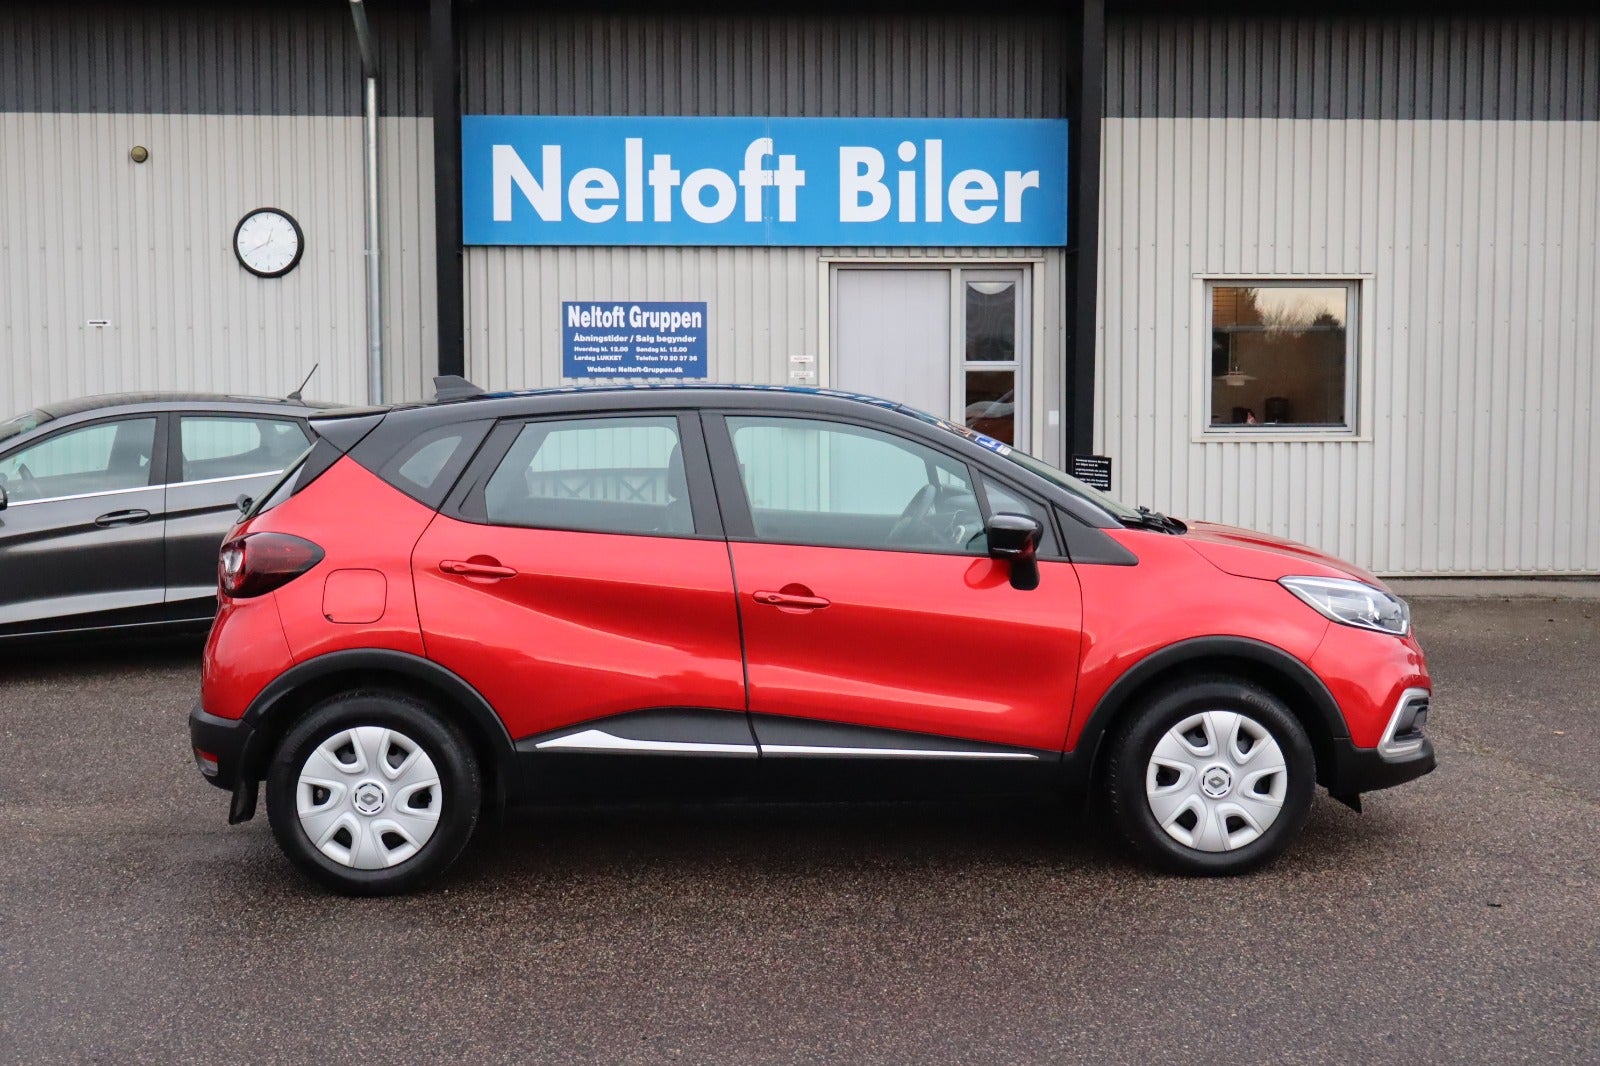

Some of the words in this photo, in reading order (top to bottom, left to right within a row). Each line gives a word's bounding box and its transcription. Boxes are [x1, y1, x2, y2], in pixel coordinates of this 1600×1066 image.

[492, 137, 806, 224] Neltoft
[839, 139, 1040, 225] Biler
[568, 305, 625, 328] Neltoft
[629, 305, 702, 332] Gruppen
[574, 332, 628, 343] Åbningstider
[630, 335, 634, 343] /
[636, 334, 655, 343] Salg
[656, 334, 697, 343] begynder
